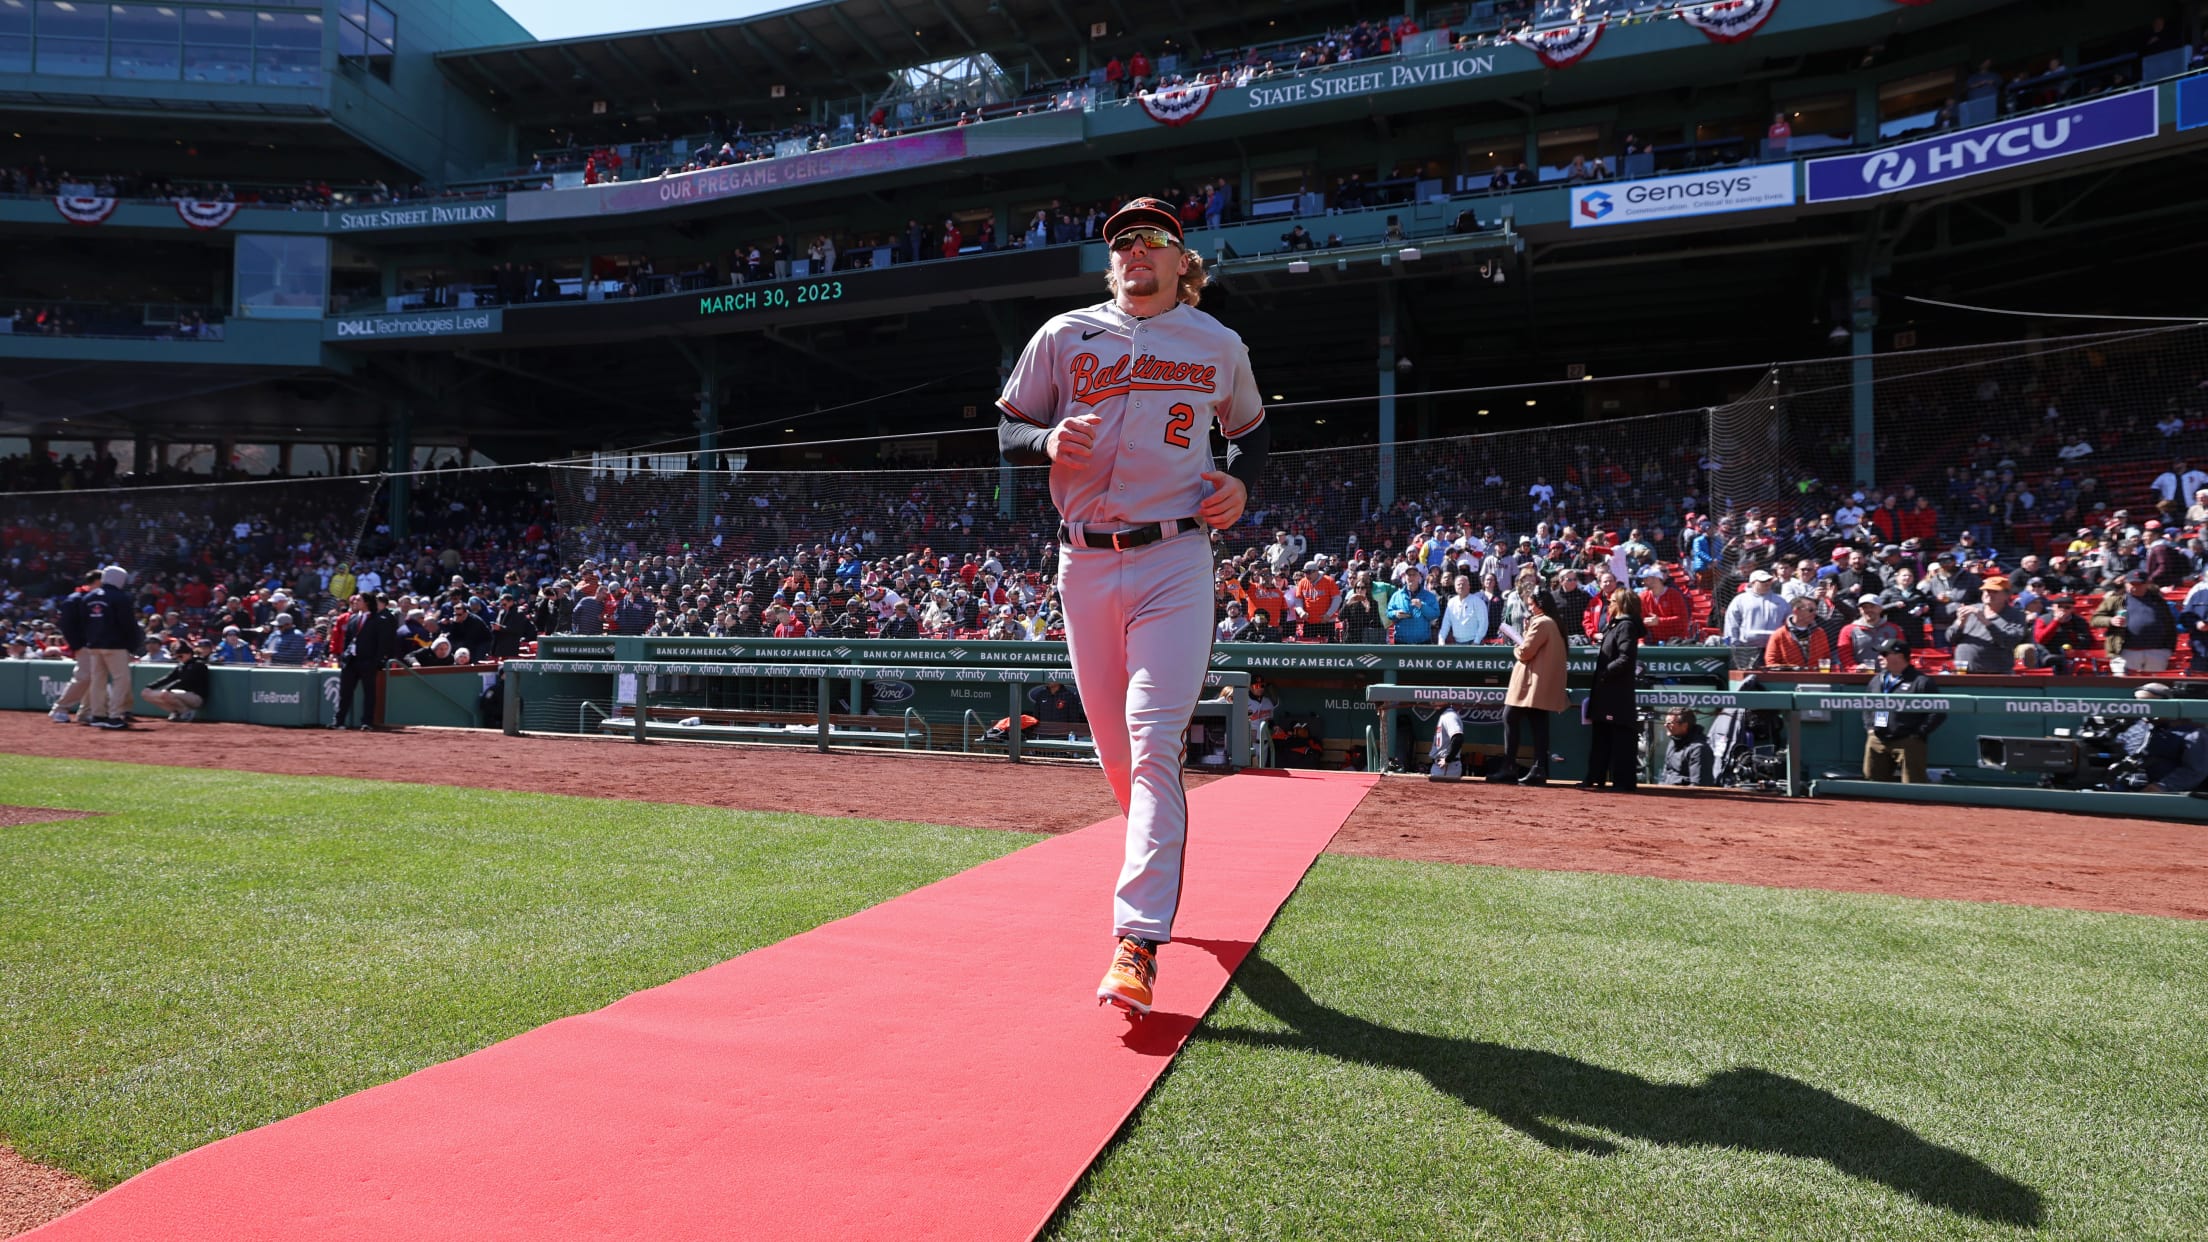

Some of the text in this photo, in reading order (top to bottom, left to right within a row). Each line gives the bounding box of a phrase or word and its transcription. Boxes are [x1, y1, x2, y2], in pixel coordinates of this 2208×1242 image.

[1250, 55, 1495, 108] STATE STREET PAVILION
[1928, 117, 2070, 174] HYCU
[660, 181, 691, 201] OUR
[698, 169, 777, 195] PREGAME
[1626, 176, 1751, 203] Genasys
[341, 205, 496, 229] STATE STREET PAVILION
[700, 281, 842, 315] MARCH 30, 2023
[375, 317, 453, 335] Technologies
[456, 314, 489, 329] Level
[1070, 352, 1216, 404] Baltimore
[1164, 402, 1194, 449] 2
[691, 648, 727, 656] AMERICA
[755, 649, 832, 657] BANK OF AMERICA
[863, 650, 946, 659] BANK OF AMERICA
[980, 652, 1070, 662] BANK OF AMERICA
[511, 662, 533, 671] xfinity
[541, 662, 563, 672] xfinity
[570, 662, 593, 672] xfinity
[601, 663, 625, 672] xfinity
[633, 663, 657, 673] xfinity
[1247, 657, 1354, 667] BANK OF AMERICA
[1398, 659, 1513, 669] BANK OF AMERICA
[666, 663, 691, 674] xfinity
[698, 664, 724, 675] xfinity
[732, 664, 758, 675] xfinity
[765, 665, 791, 676] xfinity
[799, 666, 826, 677] xfinity
[837, 666, 865, 678] xfinity
[875, 667, 905, 679] xfinity
[915, 668, 945, 680] xfinity
[956, 669, 986, 681] xfinity
[998, 669, 1030, 682] xfinity
[1048, 669, 1076, 682] xfinit
[874, 681, 904, 699] Ford
[951, 688, 991, 699] MLB.com
[1414, 688, 1506, 703] nunababy.co
[253, 691, 299, 704] LifeBrand
[1820, 695, 1949, 712] nunababy.com
[1325, 699, 1376, 710] MLB.com
[2005, 698, 2150, 716] nunababy.com
